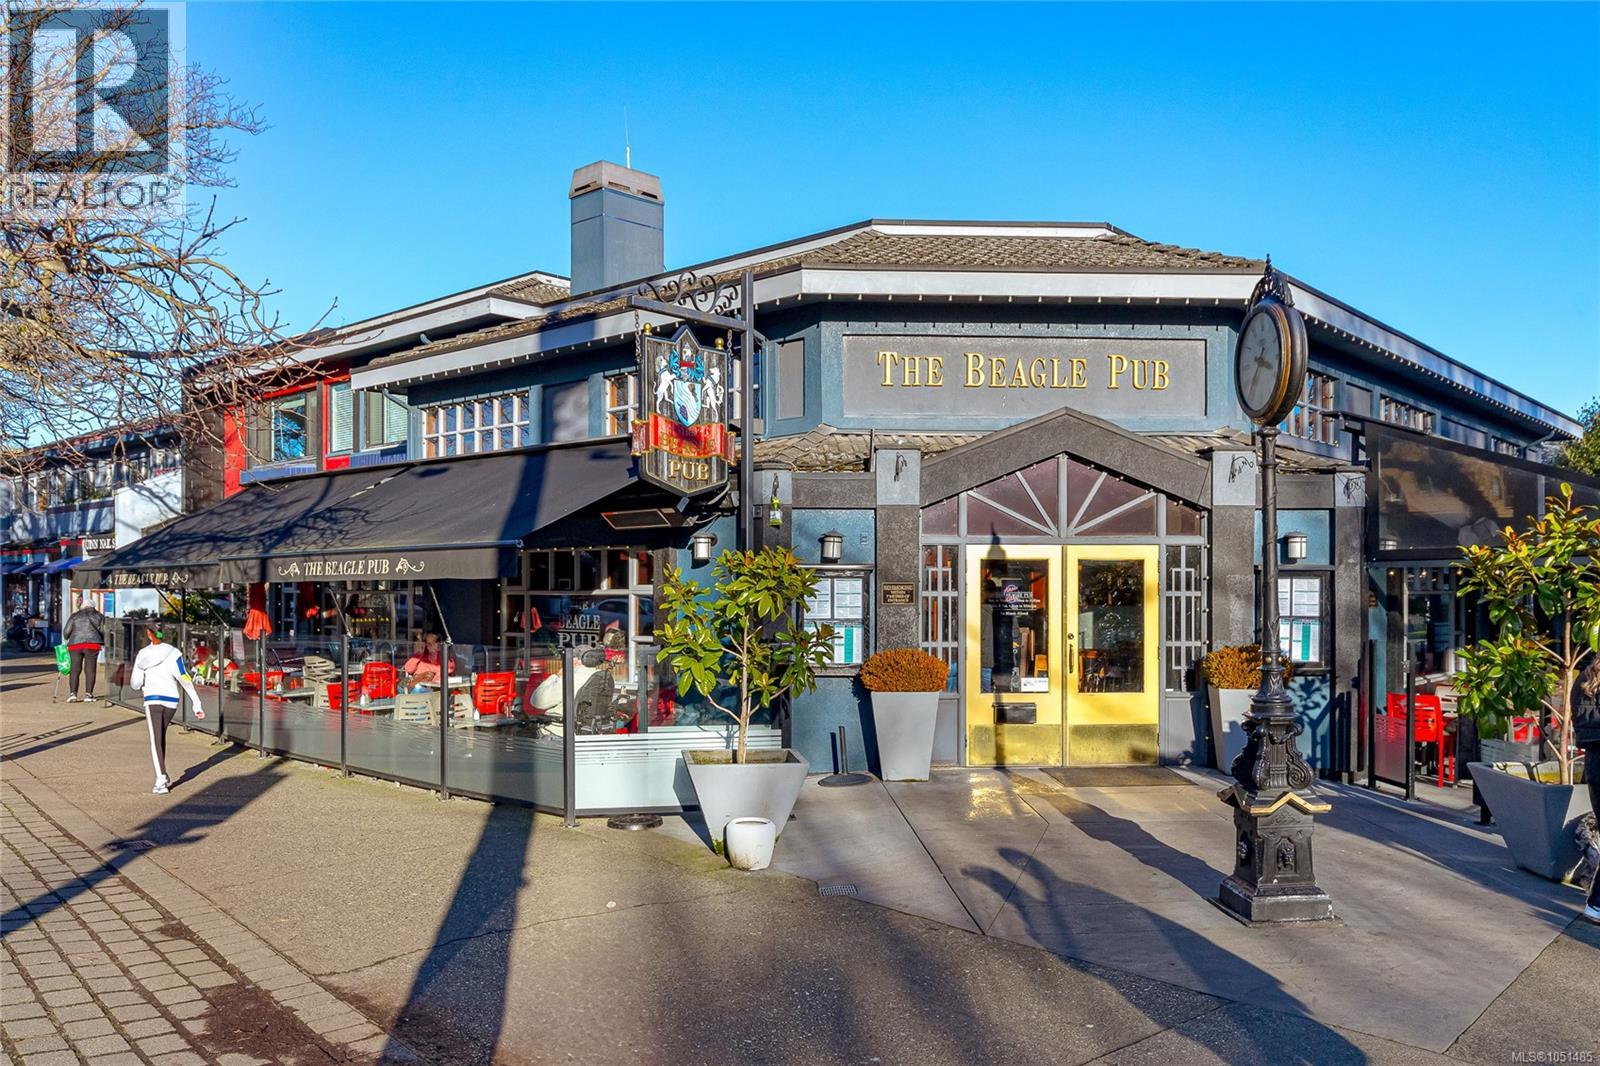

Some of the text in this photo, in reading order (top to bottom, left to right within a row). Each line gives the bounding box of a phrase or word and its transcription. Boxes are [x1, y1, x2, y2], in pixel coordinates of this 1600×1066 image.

[877, 351, 1170, 390] THE BEAGLE PUB
[668, 458, 709, 481] PUB
[304, 559, 390, 576] THE BEAGLE PUB
[559, 614, 601, 630] BEAGLE
[557, 632, 600, 650] PUB
